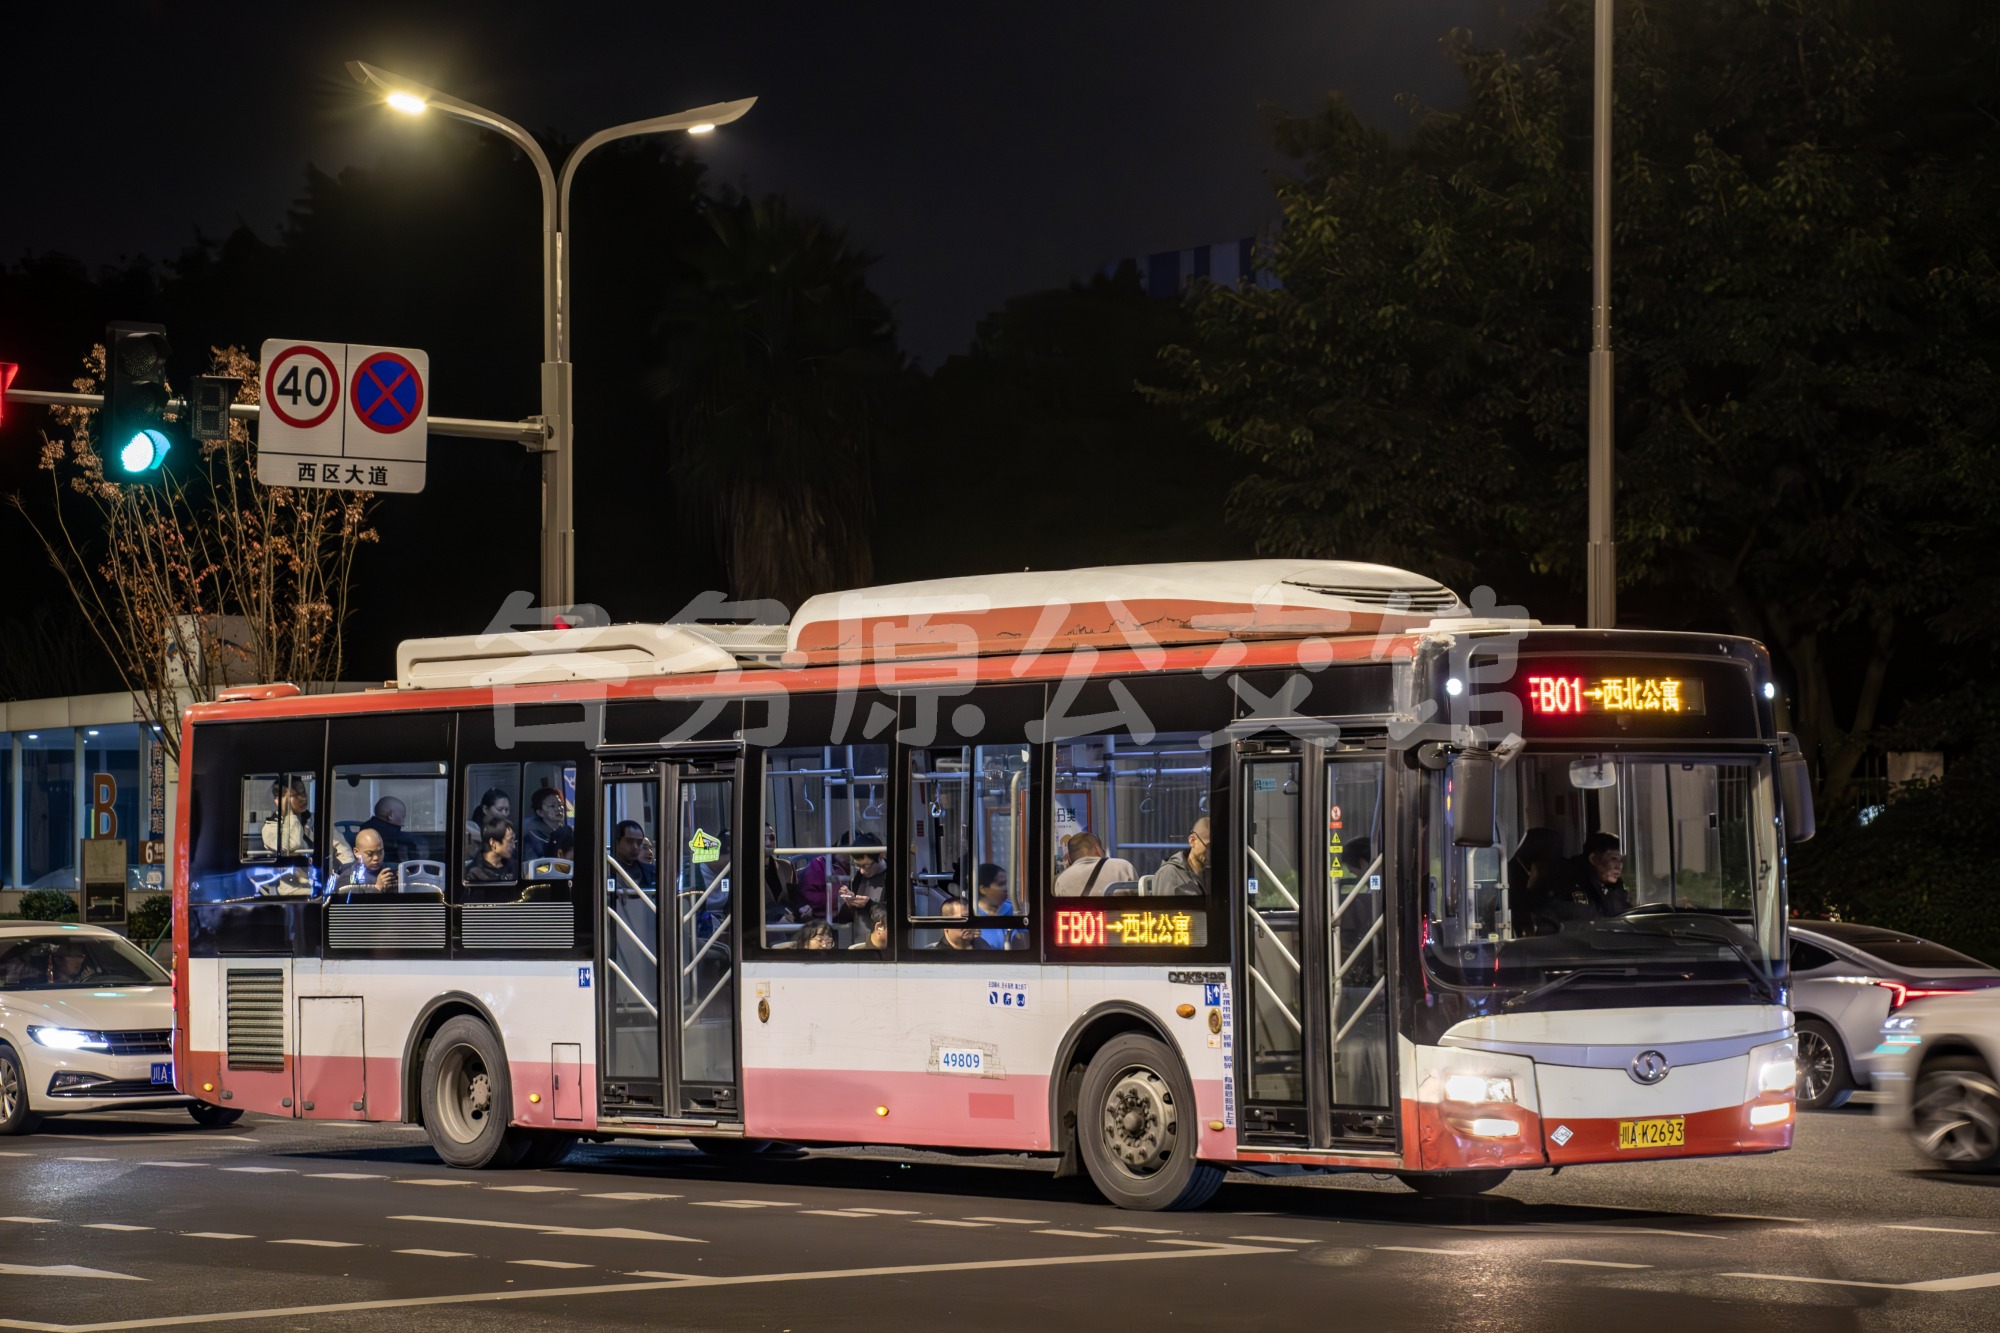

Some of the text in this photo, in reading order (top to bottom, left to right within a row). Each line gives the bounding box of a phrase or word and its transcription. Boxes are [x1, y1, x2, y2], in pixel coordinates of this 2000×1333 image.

[277, 365, 327, 407] 40
[298, 462, 388, 486] 西区大道
[1529, 677, 1680, 712] FB01 西北公寓
[93, 772, 118, 839] B
[145, 841, 153, 864] 6
[1056, 911, 1191, 946] FB01 西北公寓
[943, 1053, 980, 1068] 49809
